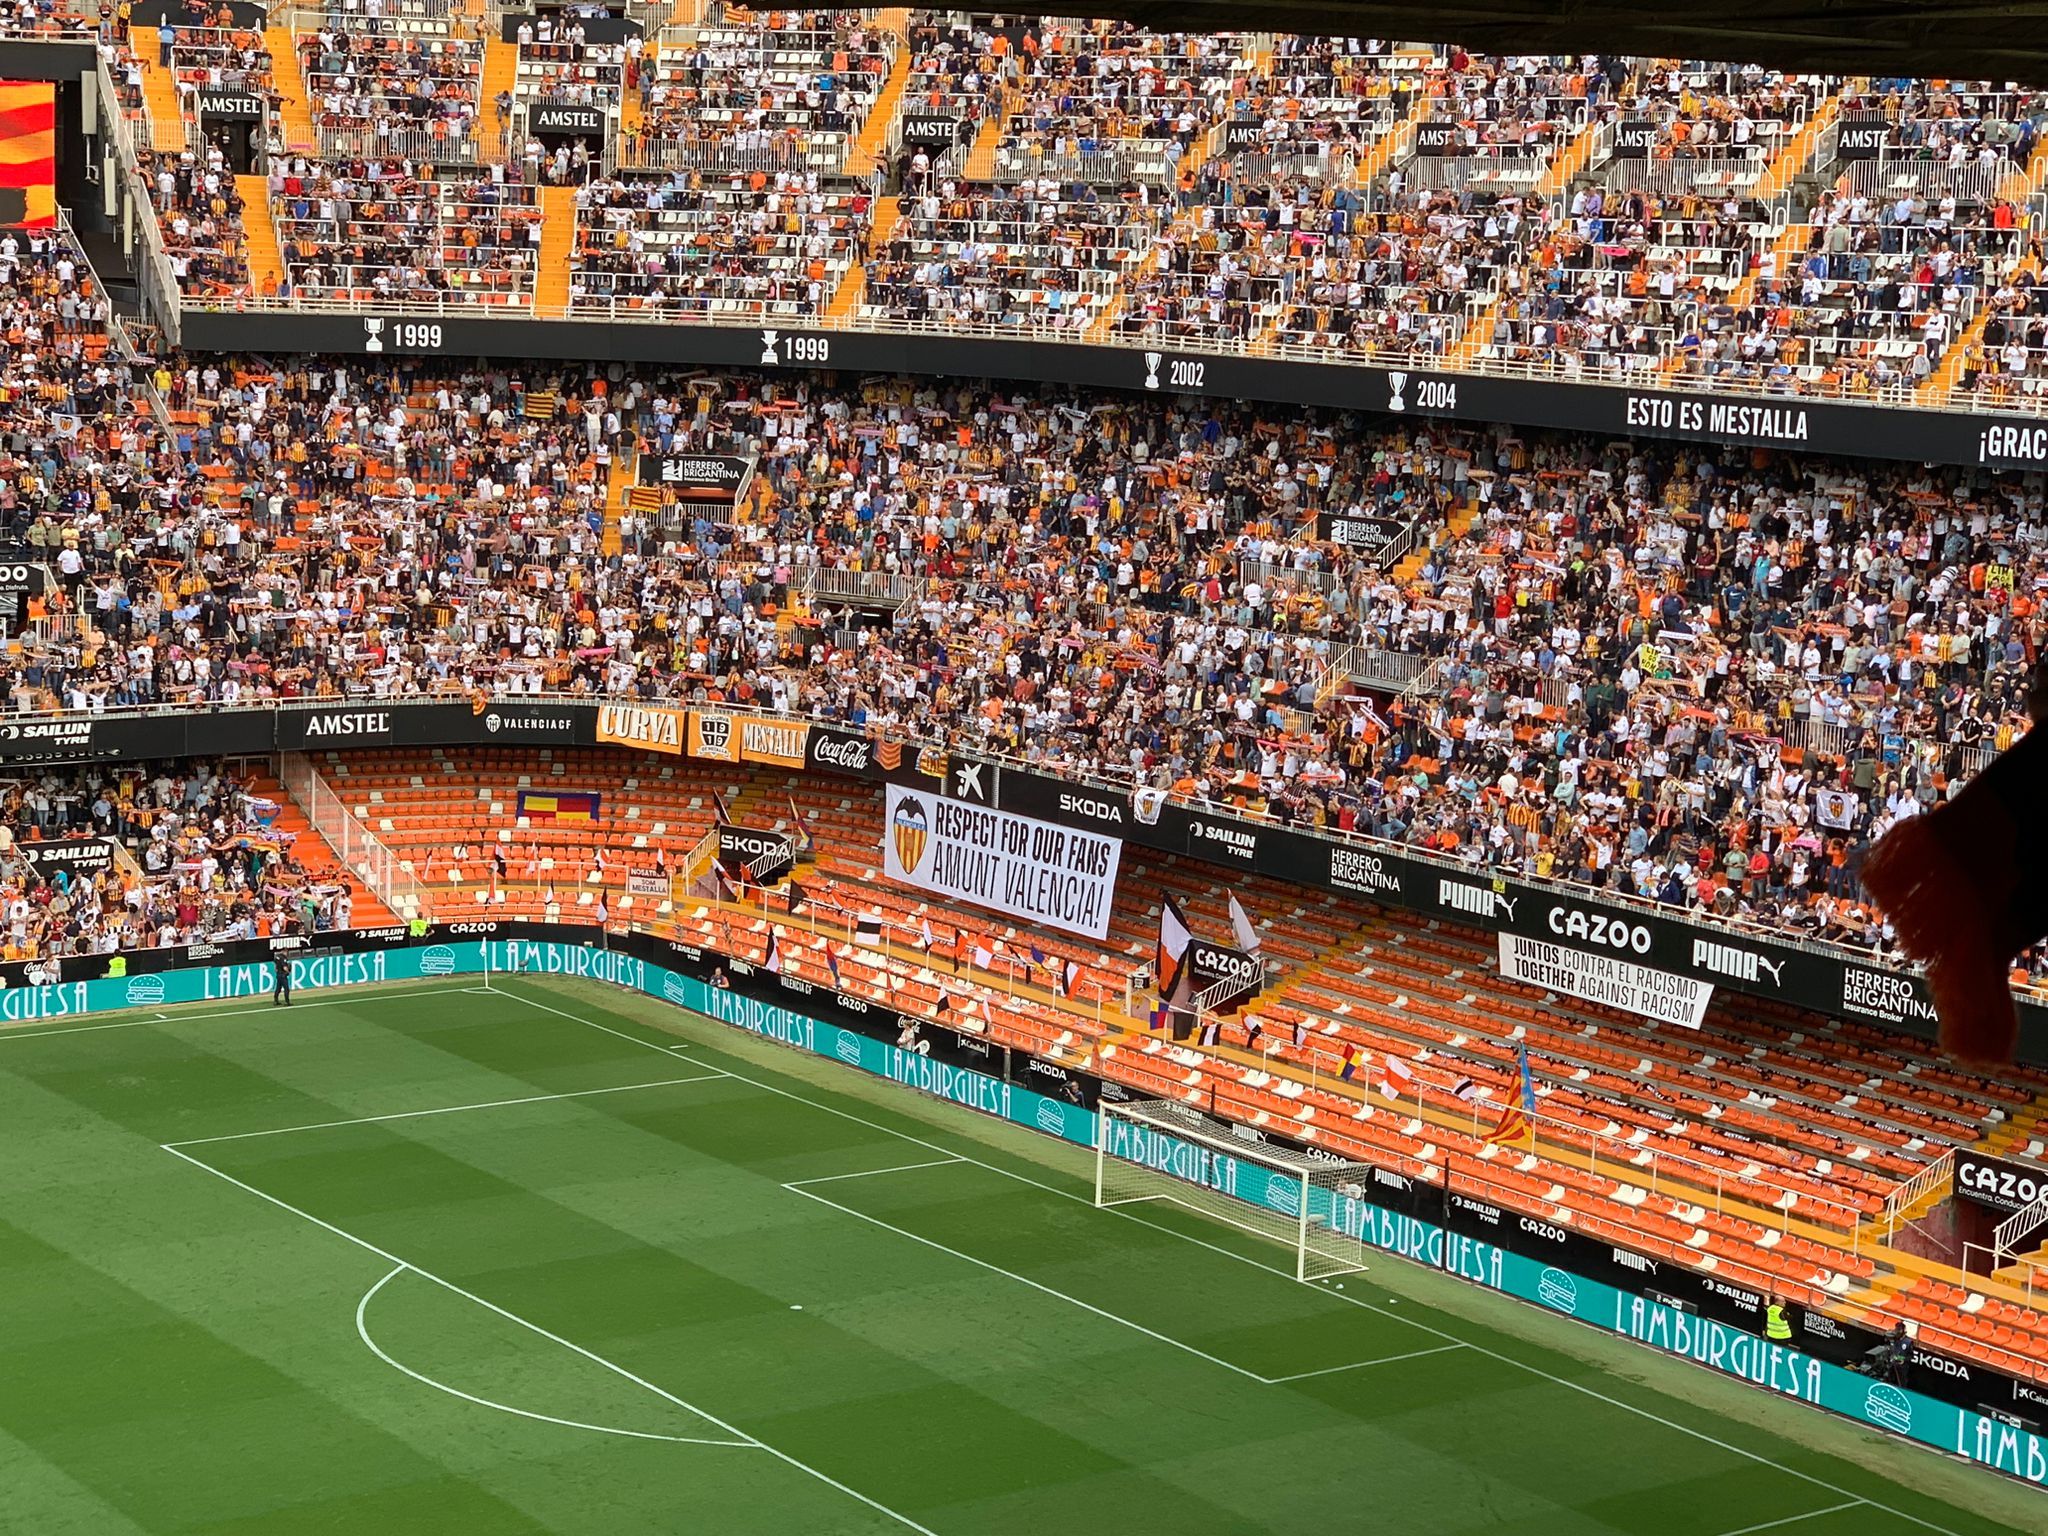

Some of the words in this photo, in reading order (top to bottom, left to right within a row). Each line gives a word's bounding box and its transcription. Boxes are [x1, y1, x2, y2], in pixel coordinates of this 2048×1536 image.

[200, 96, 260, 114] AMSTEL
[538, 111, 598, 127] AMSTEL
[905, 121, 953, 137] AMSTE
[1228, 127, 1264, 143] AMST
[1418, 130, 1450, 146] AMST
[393, 323, 441, 348] 1999
[785, 336, 829, 361] 1999
[1170, 360, 1204, 387] 2002
[1416, 380, 1457, 409] 2004
[1627, 397, 1673, 429] ESTO
[1679, 401, 1704, 431] ES
[1709, 404, 1808, 440] MESTALLA
[684, 460, 725, 470] HERRERO
[684, 469, 740, 479] BRIGANTINA
[1348, 521, 1381, 535] HERRERO
[1348, 531, 1392, 545] BRIGANTINA
[23, 722, 92, 738] SAILUN
[306, 712, 389, 736] AMSTEL
[601, 706, 679, 746] CURVA
[54, 735, 90, 746] TYRE
[743, 723, 808, 760] MESTALLA
[814, 734, 870, 770] Coca-Cola
[936, 801, 998, 850] RESPECT
[1001, 818, 1028, 858] FOR
[1031, 826, 1064, 867] OUR
[1067, 834, 1111, 878] FANS
[1205, 826, 1256, 849] SAILUN
[42, 845, 110, 861] SAILUN
[72, 858, 107, 868] TYRE
[1227, 845, 1254, 859] TYRE
[1331, 848, 1382, 873] HERRERO
[632, 884, 667, 893] MESTALLA
[931, 841, 1000, 900] AMUNT
[1004, 859, 1104, 930] VALENCIA!
[1331, 862, 1400, 892] BRIGANTINA
[1439, 879, 1494, 918] PUMA
[368, 928, 405, 938] SAILUN
[450, 922, 497, 934] CAZOO
[1549, 907, 1651, 954] CAZOO
[269, 936, 299, 950] PUMA
[677, 944, 701, 957] SAILUN
[491, 941, 644, 991] LAMBURGUESA
[1195, 948, 1252, 978] CAZOO
[1513, 938, 1560, 965] JUNTOS
[1564, 951, 1614, 980] CONTRA
[1618, 963, 1632, 984] EL
[1637, 967, 1698, 1001] RACISMO
[1692, 939, 1758, 982] PUMA
[204, 951, 386, 999] LAMBRGUESA
[781, 976, 805, 992] VALENCIA
[805, 984, 812, 995] CF
[1845, 967, 1913, 998] HERRERO
[2, 981, 88, 1020] GUESA
[1515, 958, 1575, 992] TOGETHER
[1579, 973, 1636, 1008] AGAINST
[1641, 991, 1695, 1023] RACISM
[837, 995, 868, 1014] CAZOO
[1843, 1001, 1878, 1017] Insurance
[1879, 1009, 1904, 1022] Broker
[1844, 984, 1939, 1022] BRIGANTINA
[704, 984, 814, 1051] LAMBURGUESA
[885, 1044, 1010, 1119] LAMBURGUESA
[1091, 1113, 1236, 1196] LAMBURGUESA
[1306, 1147, 1347, 1168] CAZOO
[1374, 1168, 1403, 1190] PUMA
[1463, 1199, 1501, 1218] SAILUN
[1479, 1213, 1499, 1226] TYRE
[1332, 1192, 1503, 1290] LAMBURGUESA
[1519, 1217, 1567, 1243] CAZOO
[1613, 1248, 1646, 1272] PUMA
[1716, 1283, 1760, 1306] SAILUN
[1734, 1300, 1758, 1313] TYRE
[1804, 1311, 1836, 1328] HERRERO
[1804, 1319, 1846, 1340] BRIGANTINA
[1615, 1291, 1822, 1404] LAMBURGUESA
[1957, 1408, 2047, 1482] LAMB
